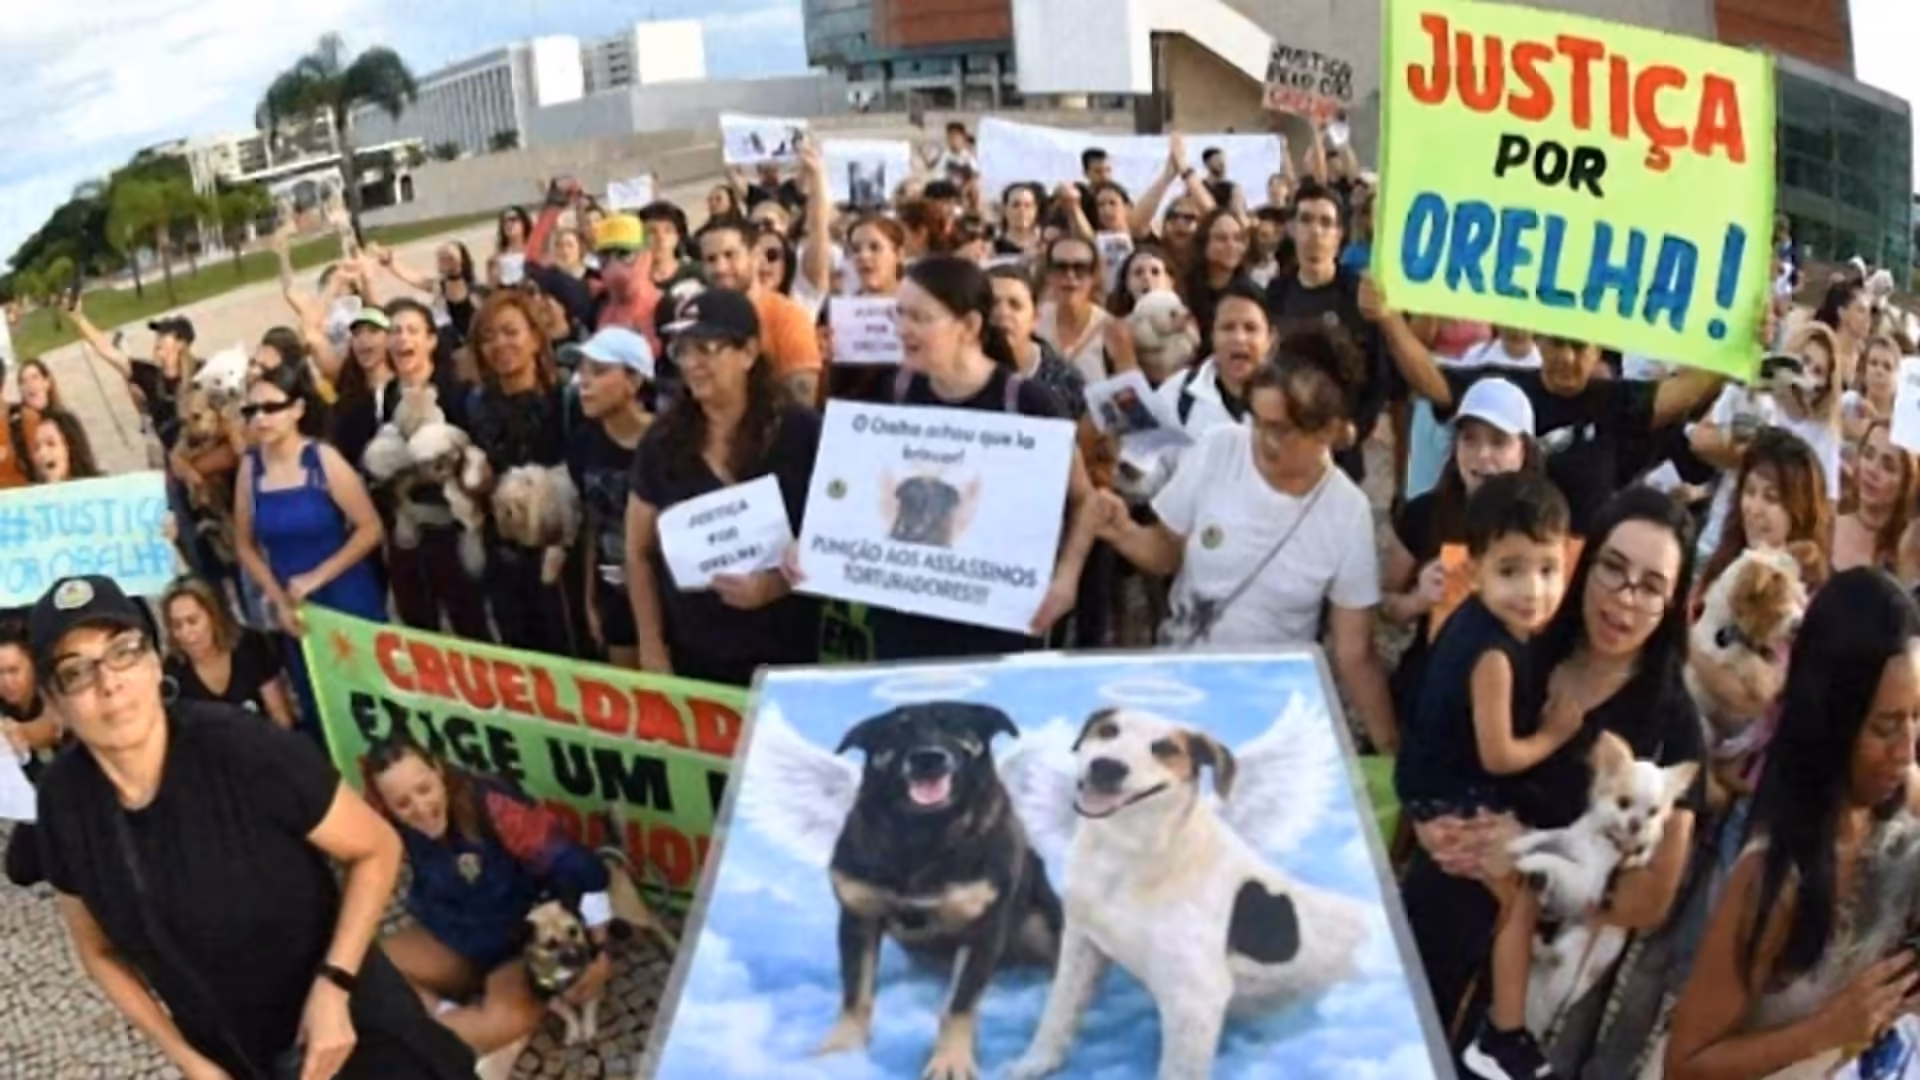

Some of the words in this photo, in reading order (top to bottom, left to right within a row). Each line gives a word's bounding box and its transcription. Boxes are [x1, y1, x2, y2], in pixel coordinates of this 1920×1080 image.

[1407, 12, 1745, 172] JUSTIÇA
[1493, 133, 1606, 198] POR
[852, 413, 869, 434] O
[0, 557, 44, 594] OR
[923, 553, 1039, 588] ASSASSINOS
[547, 737, 673, 812] UM
